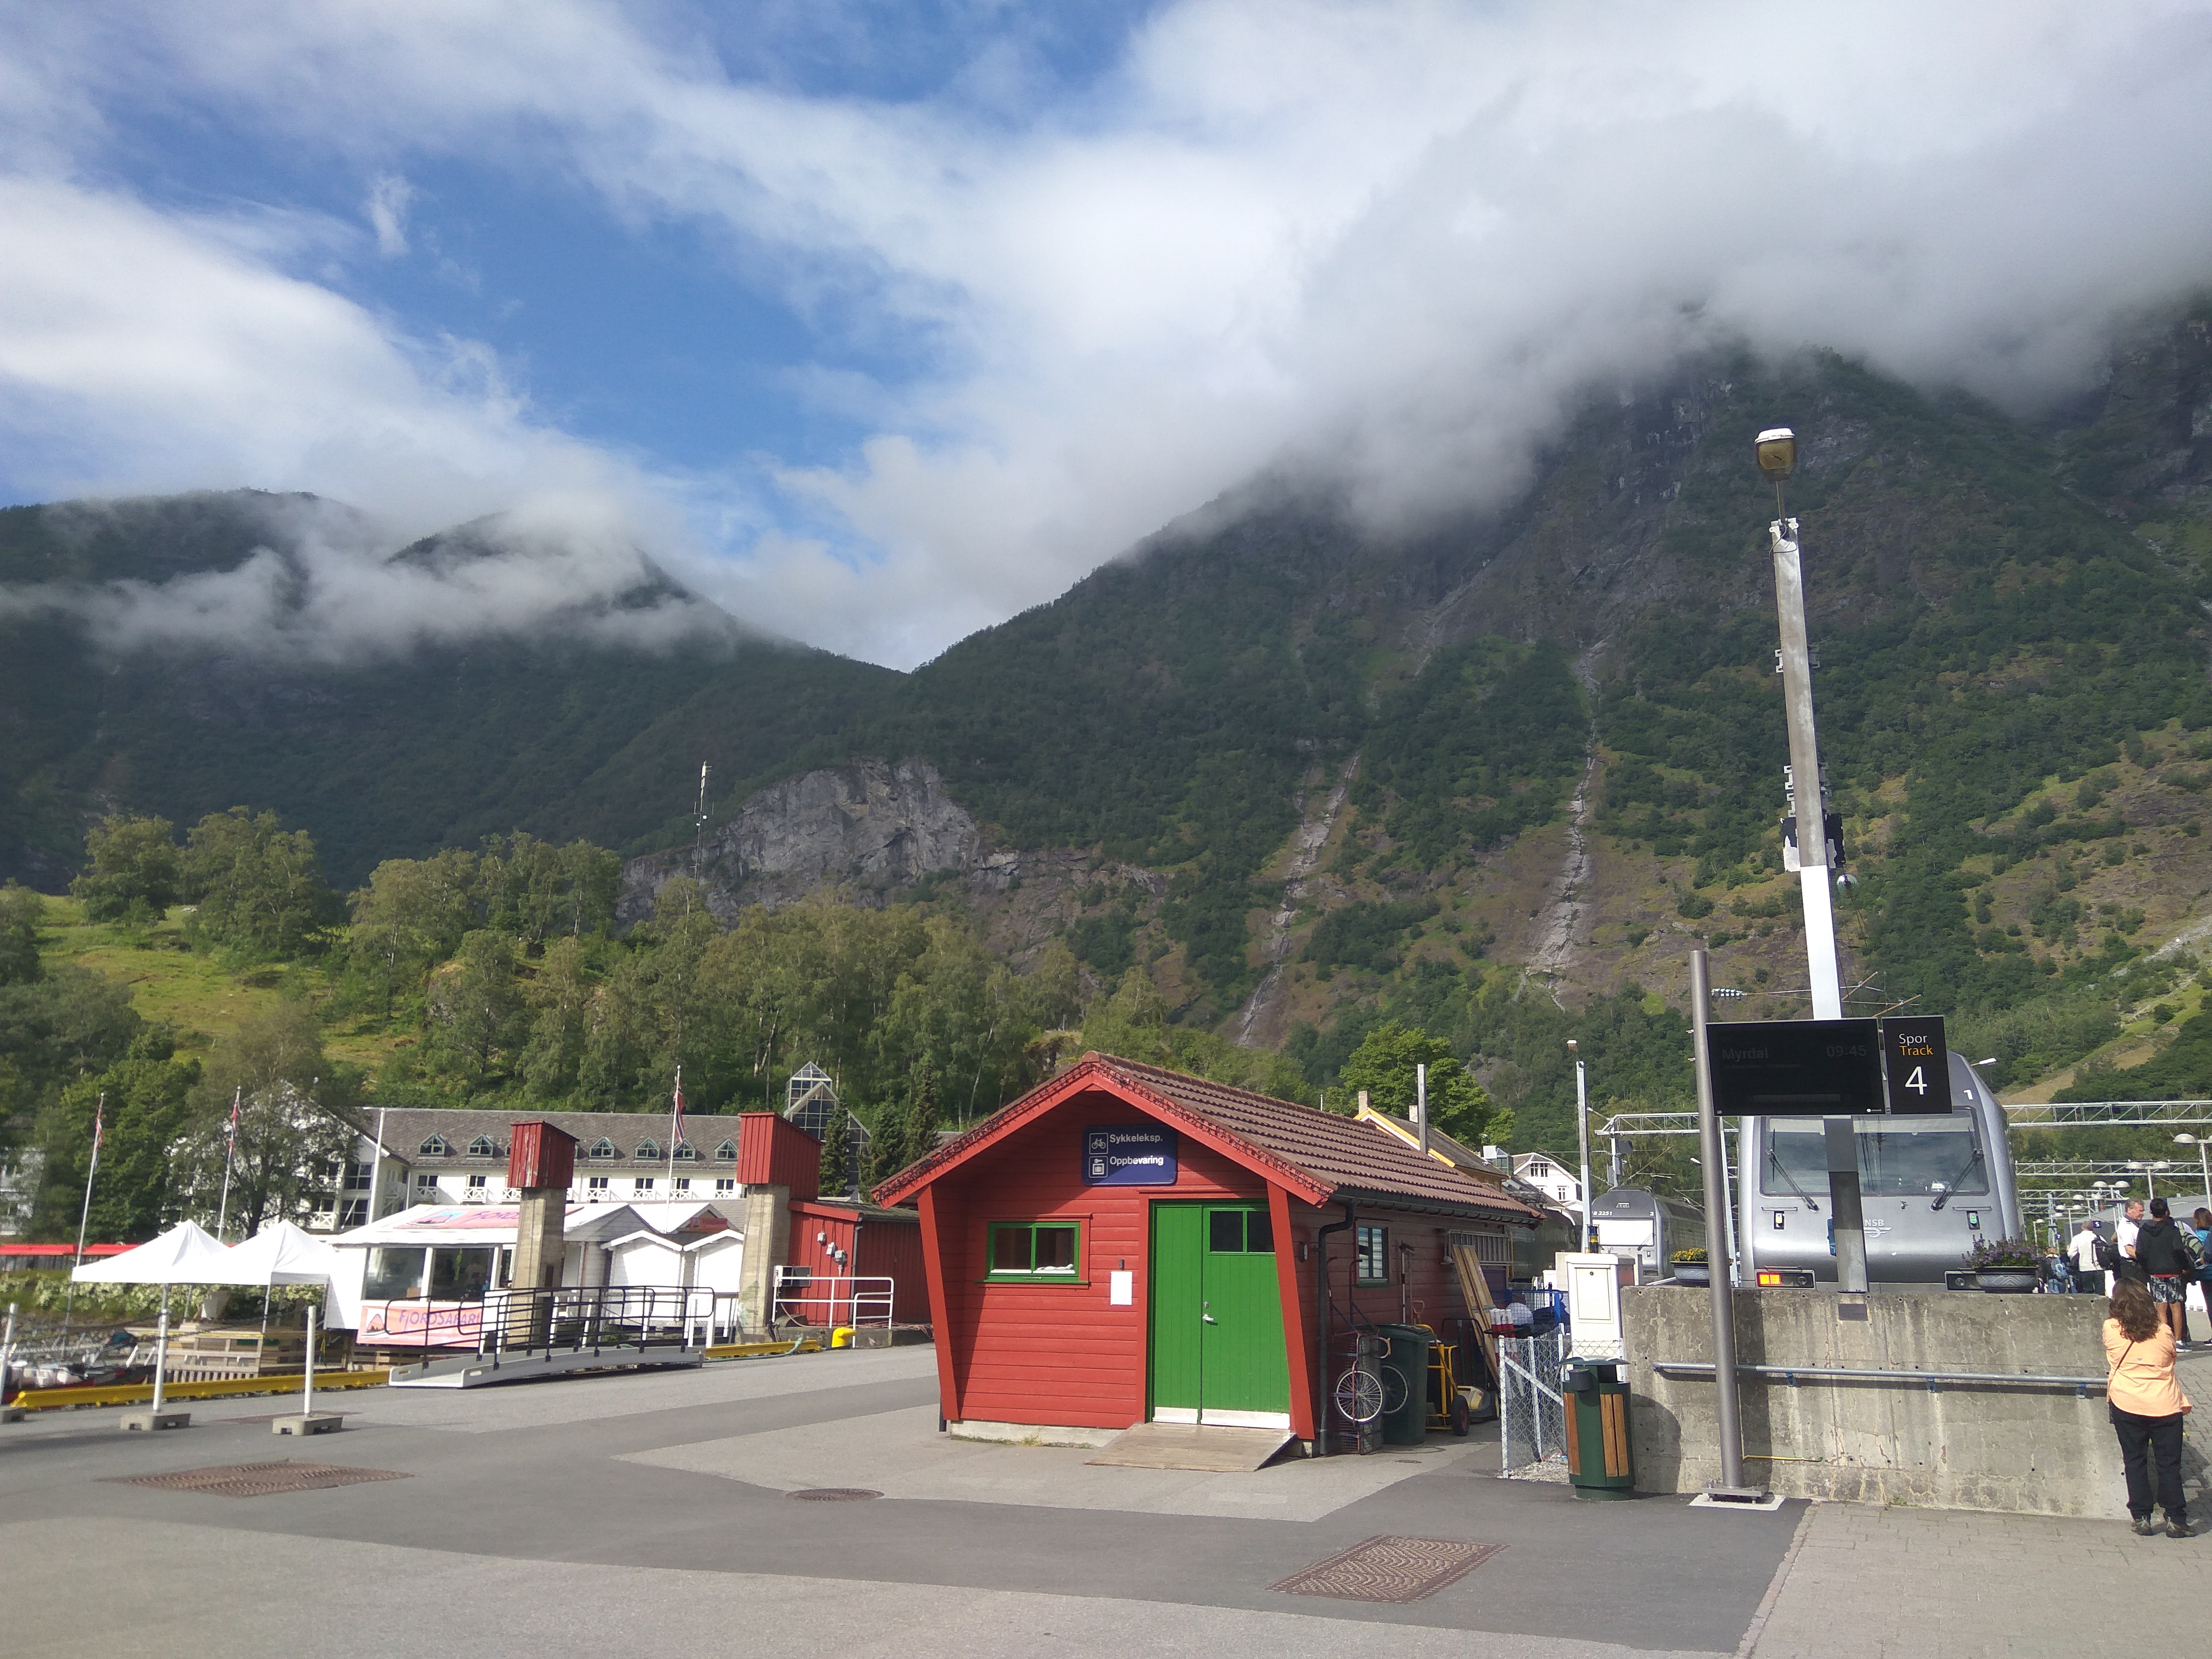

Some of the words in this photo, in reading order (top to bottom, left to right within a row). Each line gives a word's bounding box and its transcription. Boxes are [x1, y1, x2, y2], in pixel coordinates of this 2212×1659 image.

[1899, 1033, 1928, 1046] Spor
[1722, 1047, 1768, 1062] Myrdal
[1899, 1044, 1934, 1056] Track
[1905, 1066, 1928, 1095] 4
[1963, 1089, 1973, 1100] 1
[1109, 1133, 1163, 1144] Sykkeleksp.
[1109, 1155, 1164, 1166] Oppbevaring
